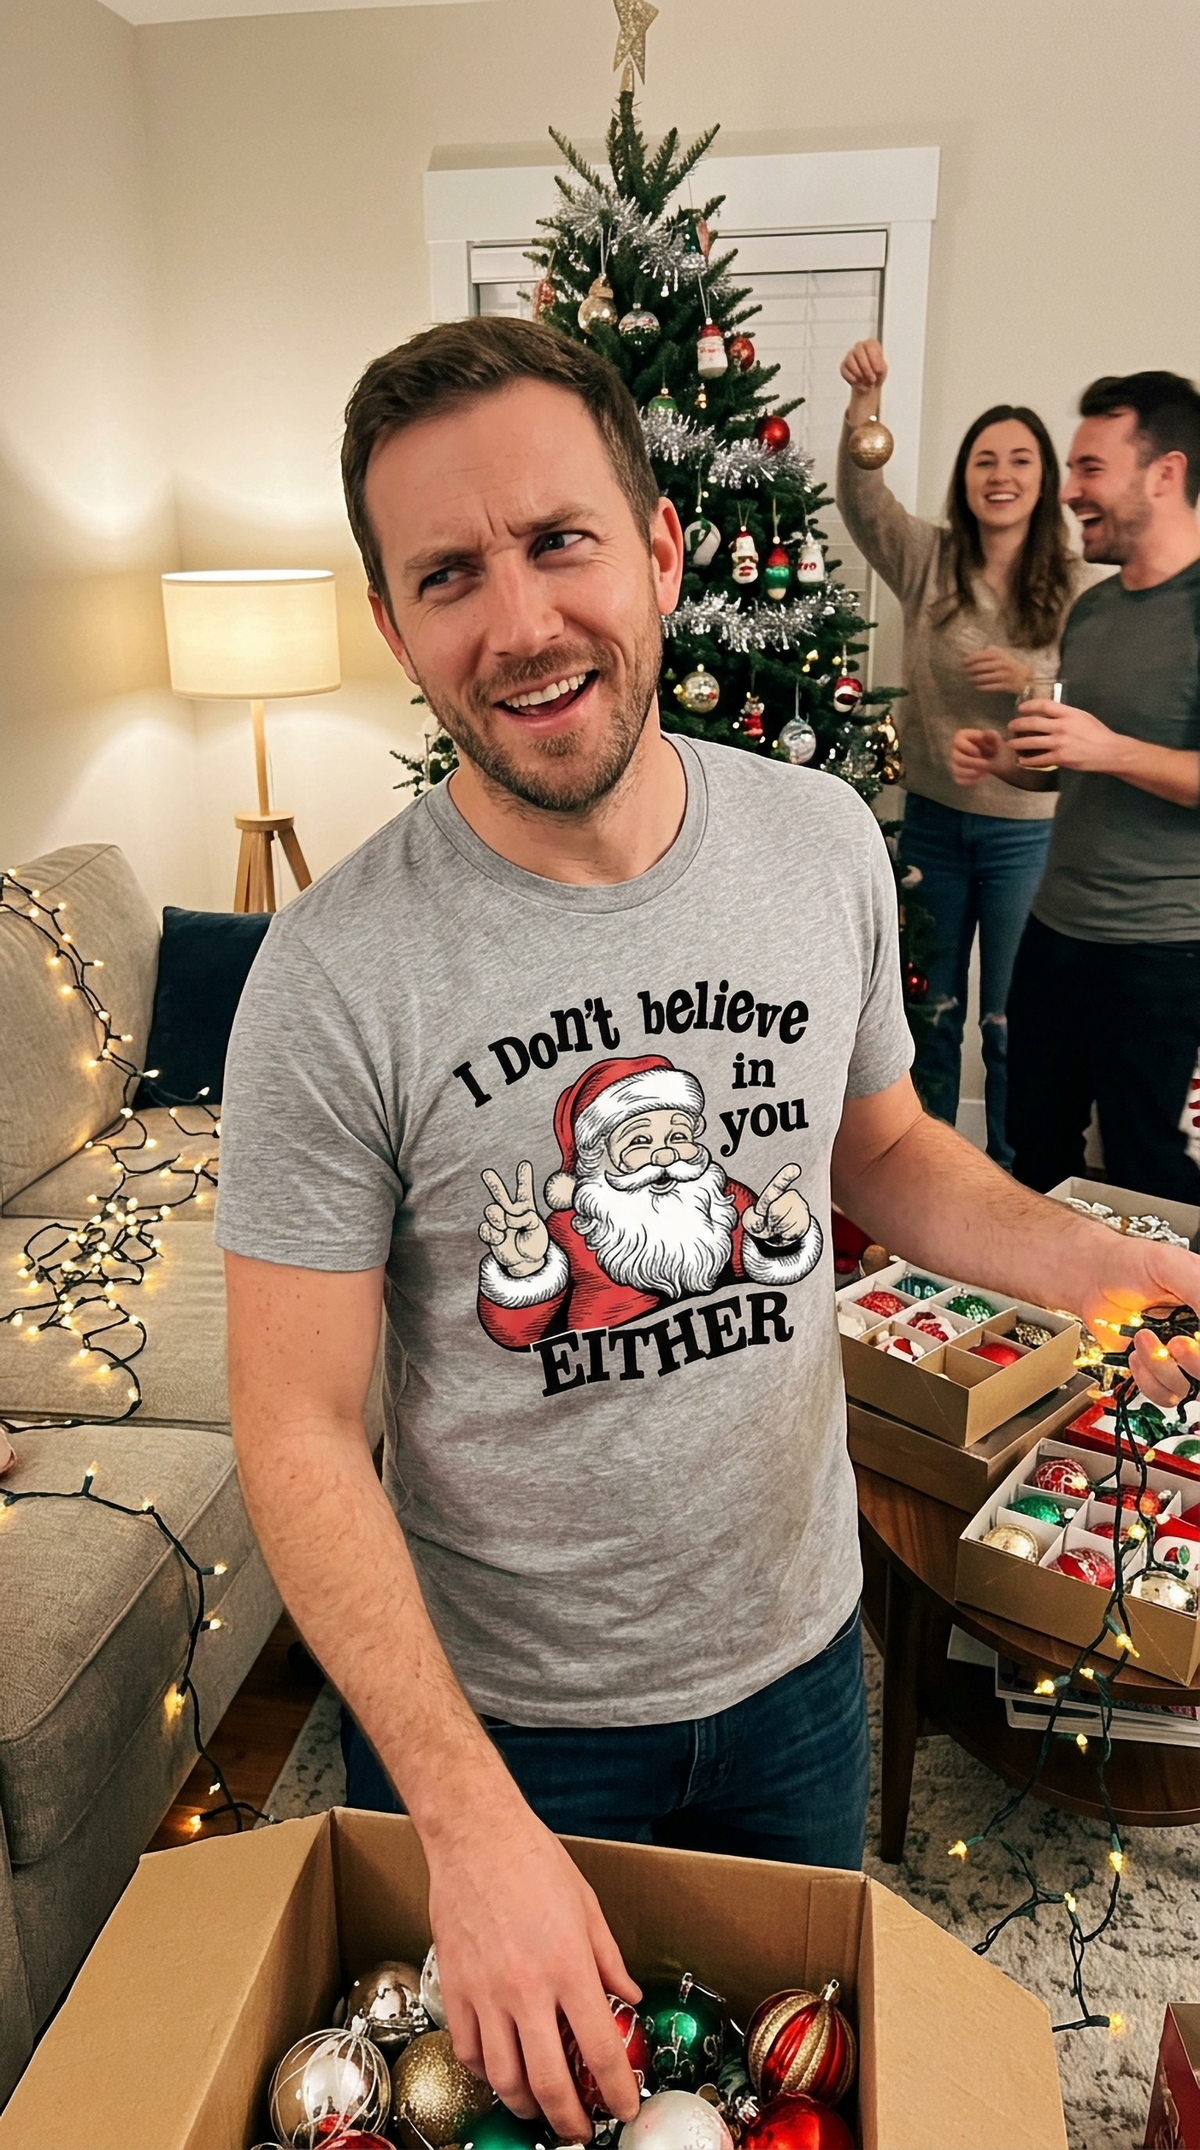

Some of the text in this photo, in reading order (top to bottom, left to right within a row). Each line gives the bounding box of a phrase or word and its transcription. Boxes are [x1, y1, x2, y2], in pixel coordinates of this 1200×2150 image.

[453, 979, 809, 1107] I Don't believe
[731, 1052, 776, 1089] in
[719, 1098, 809, 1157] you
[531, 1291, 794, 1397] EITHER
